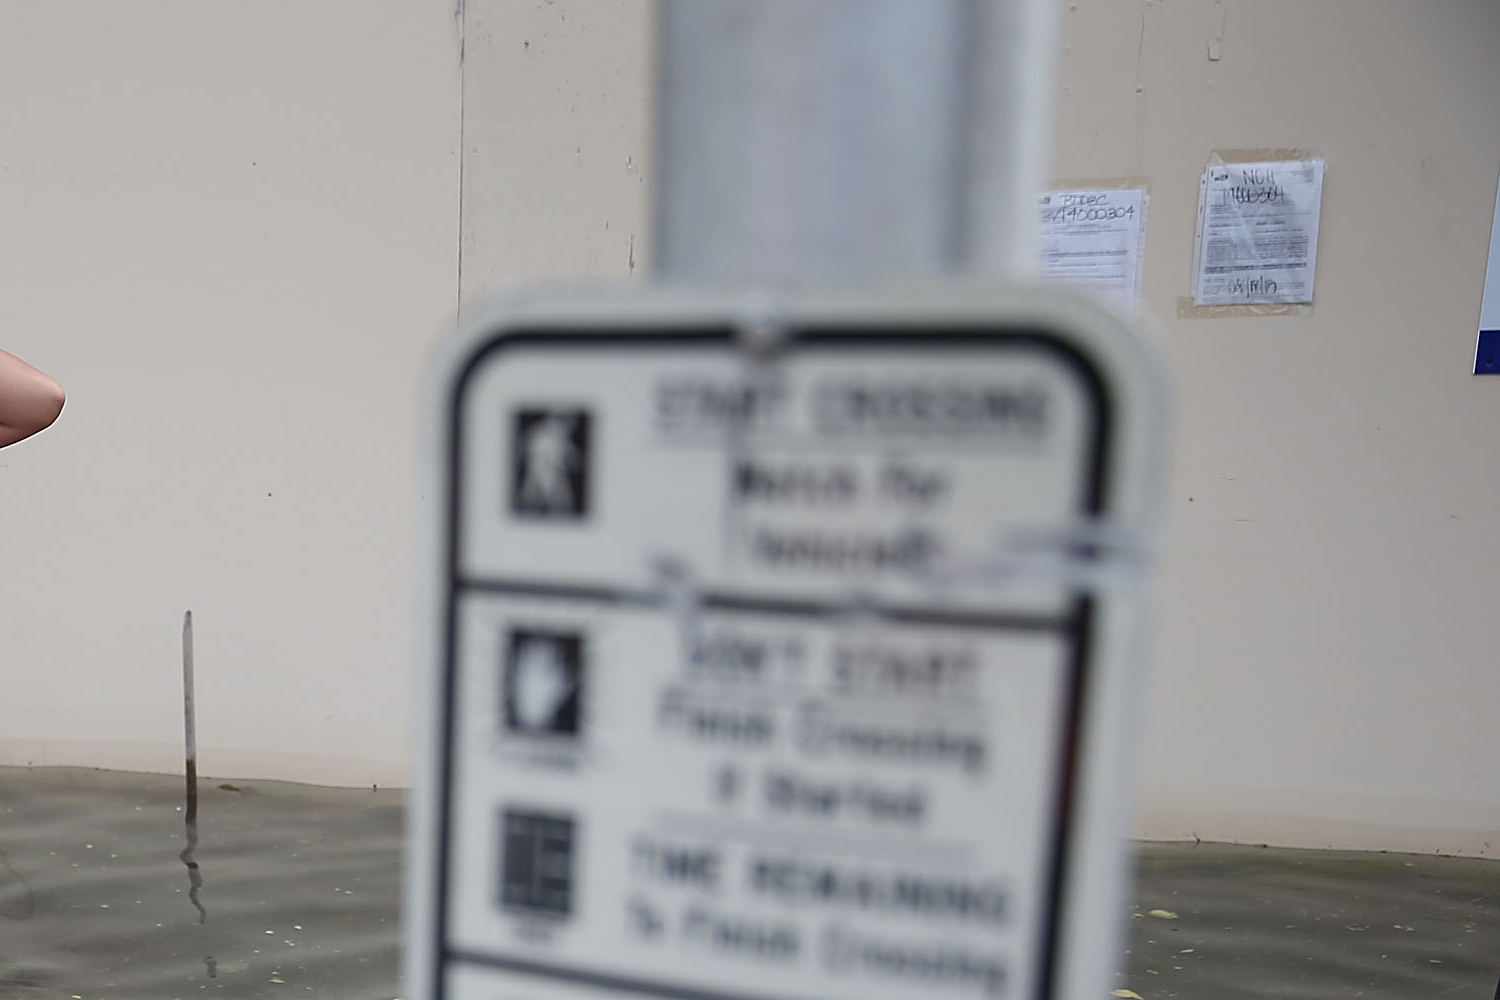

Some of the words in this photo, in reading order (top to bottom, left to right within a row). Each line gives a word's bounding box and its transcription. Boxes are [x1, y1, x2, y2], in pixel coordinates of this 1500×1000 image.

[812, 386, 1048, 434] CROSSING
[797, 701, 987, 778] Crossing
[765, 769, 925, 822] Started
[632, 832, 722, 894] TIME
[750, 855, 1008, 924] REMAINING
[680, 905, 801, 957] Finish
[819, 922, 1007, 992] Crossing
